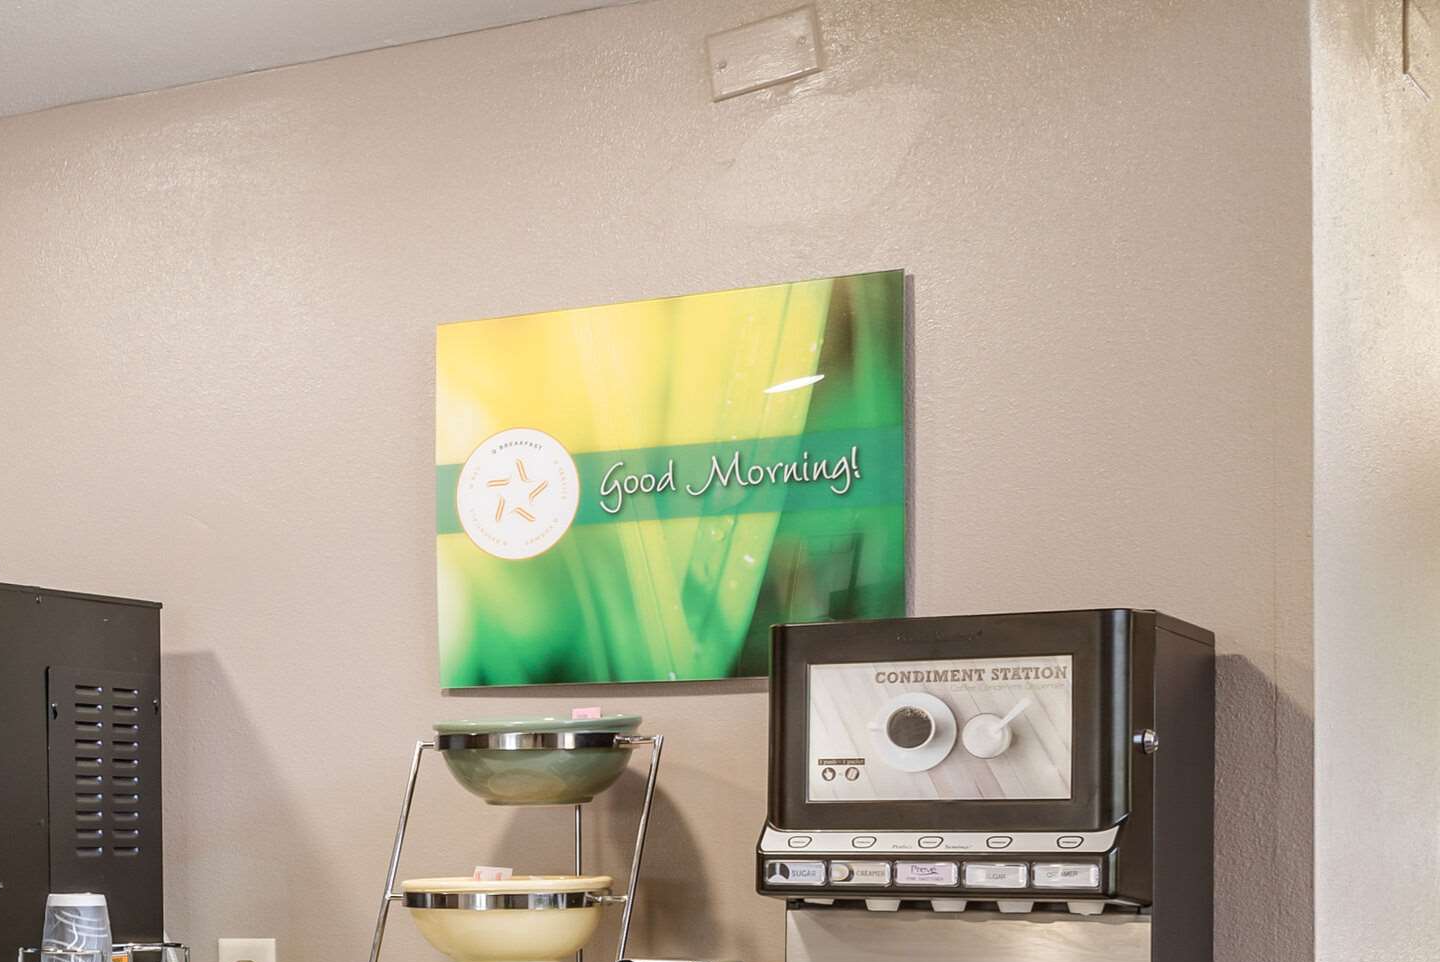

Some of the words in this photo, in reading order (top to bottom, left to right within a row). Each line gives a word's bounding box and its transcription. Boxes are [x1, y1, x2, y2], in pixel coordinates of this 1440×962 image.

[599, 459, 677, 514] Good
[685, 446, 861, 495] Morning!
[875, 669, 986, 684] CONDIMENT
[991, 666, 1068, 681] STATION
[792, 869, 816, 878] SUGAR
